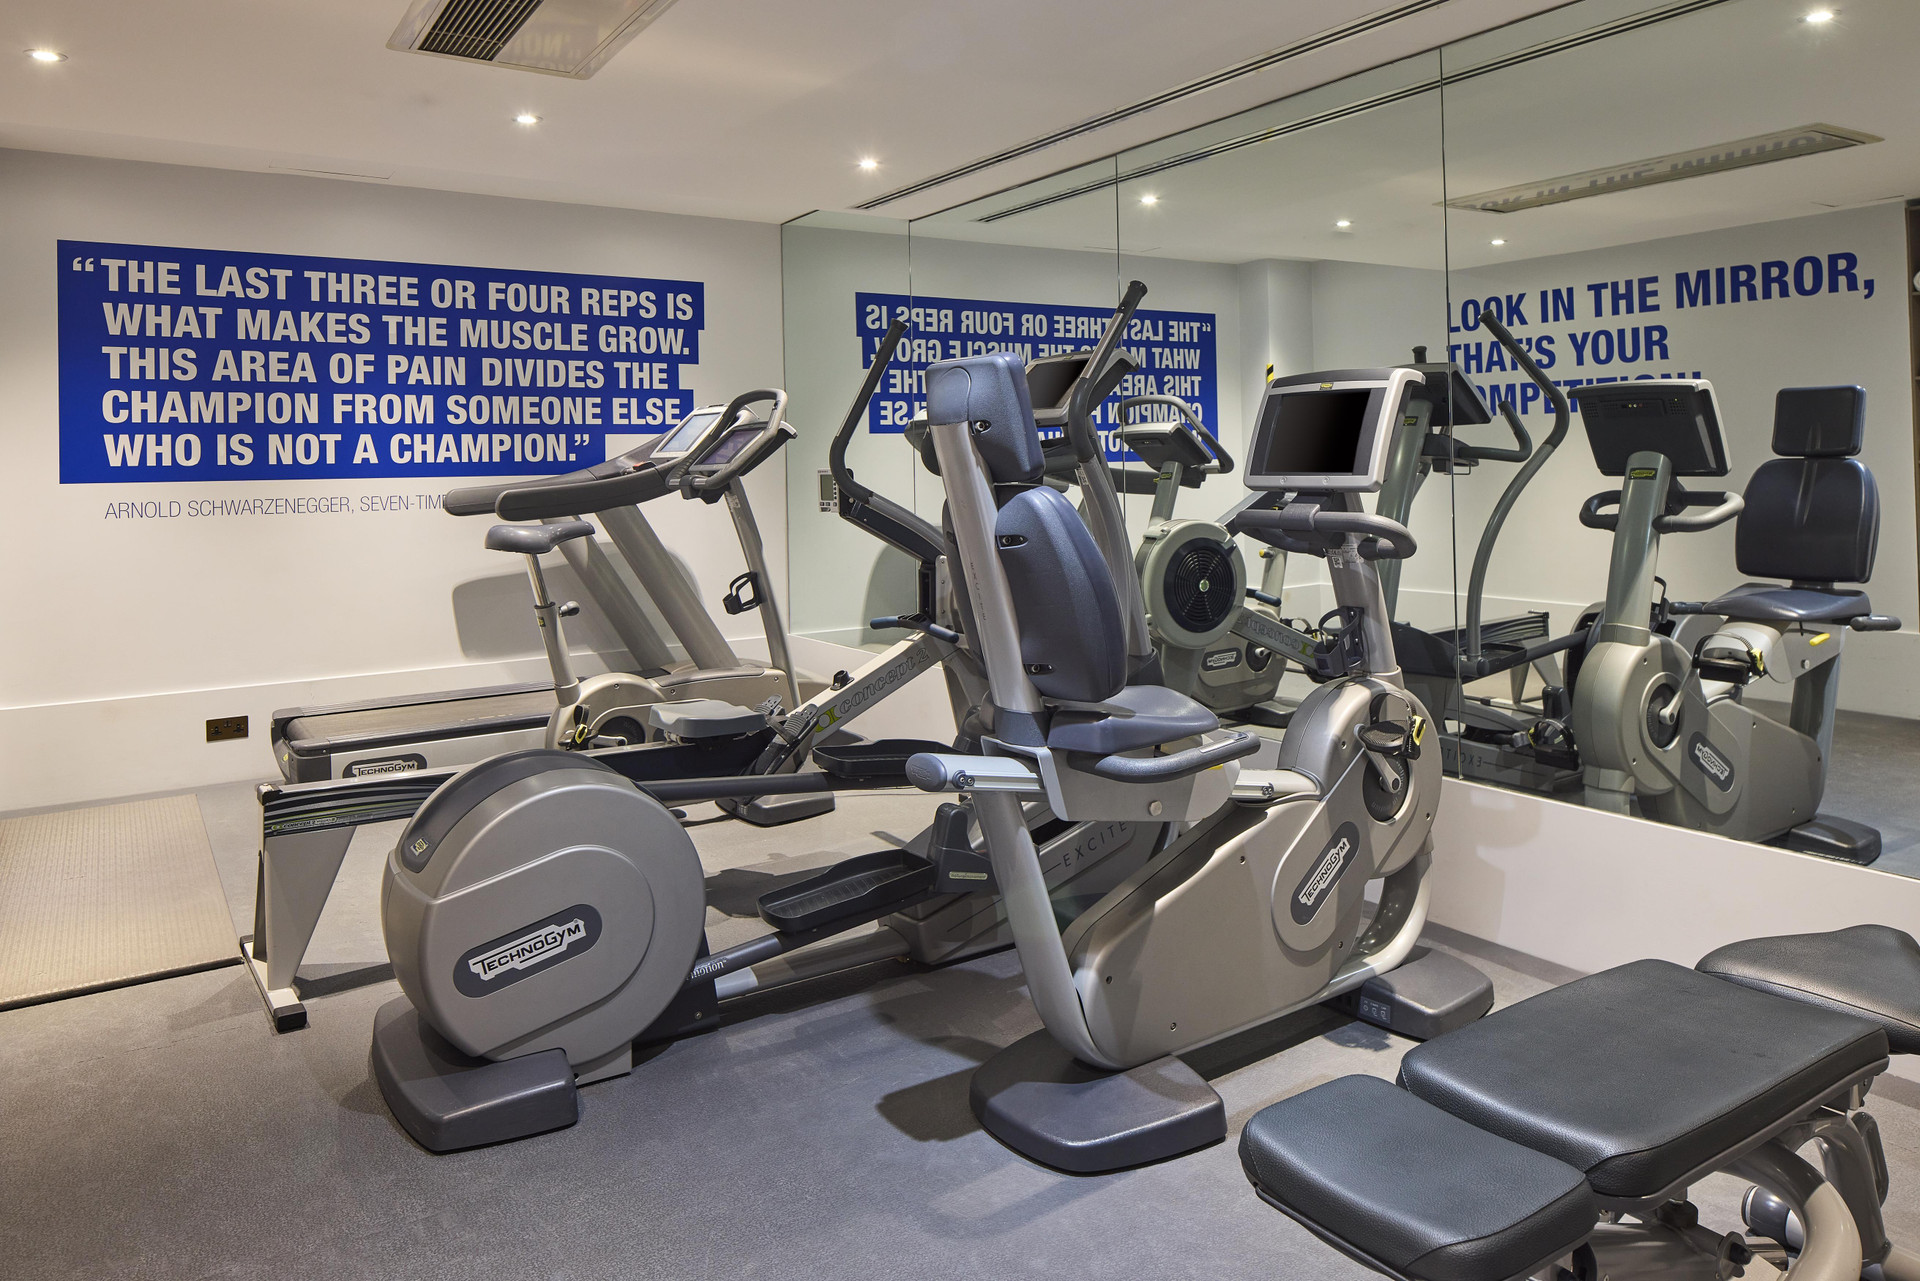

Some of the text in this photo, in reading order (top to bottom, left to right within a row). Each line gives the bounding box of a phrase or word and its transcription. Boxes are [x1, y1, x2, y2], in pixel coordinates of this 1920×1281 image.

[196, 265, 293, 300] LAST
[304, 271, 418, 307] THREE
[431, 279, 477, 310] OR
[488, 282, 571, 315] FOUR
[581, 288, 657, 319] REPS
[667, 293, 693, 321] IS
[1540, 286, 1575, 323] IN
[1587, 275, 1660, 318] THE
[1675, 251, 1875, 310] MIRROR,
[102, 303, 690, 355] WHAT MAKES THE MUSCLE GROW.
[1568, 325, 1670, 366] YOUR
[101, 346, 669, 390] THIS AREA OF PAIN DIVIDES THE
[102, 390, 681, 426] CHAMPION FROM SOMEONE ELSE
[103, 433, 202, 467] WHO
[216, 433, 254, 466] IS
[268, 433, 342, 466] NOT
[352, 433, 379, 464] A
[104, 500, 182, 519] ARNOLD
[188, 495, 355, 518] SCHWARZENEGGER,
[840, 647, 930, 715] concept 2
[1063, 821, 1128, 868] EXCITE
